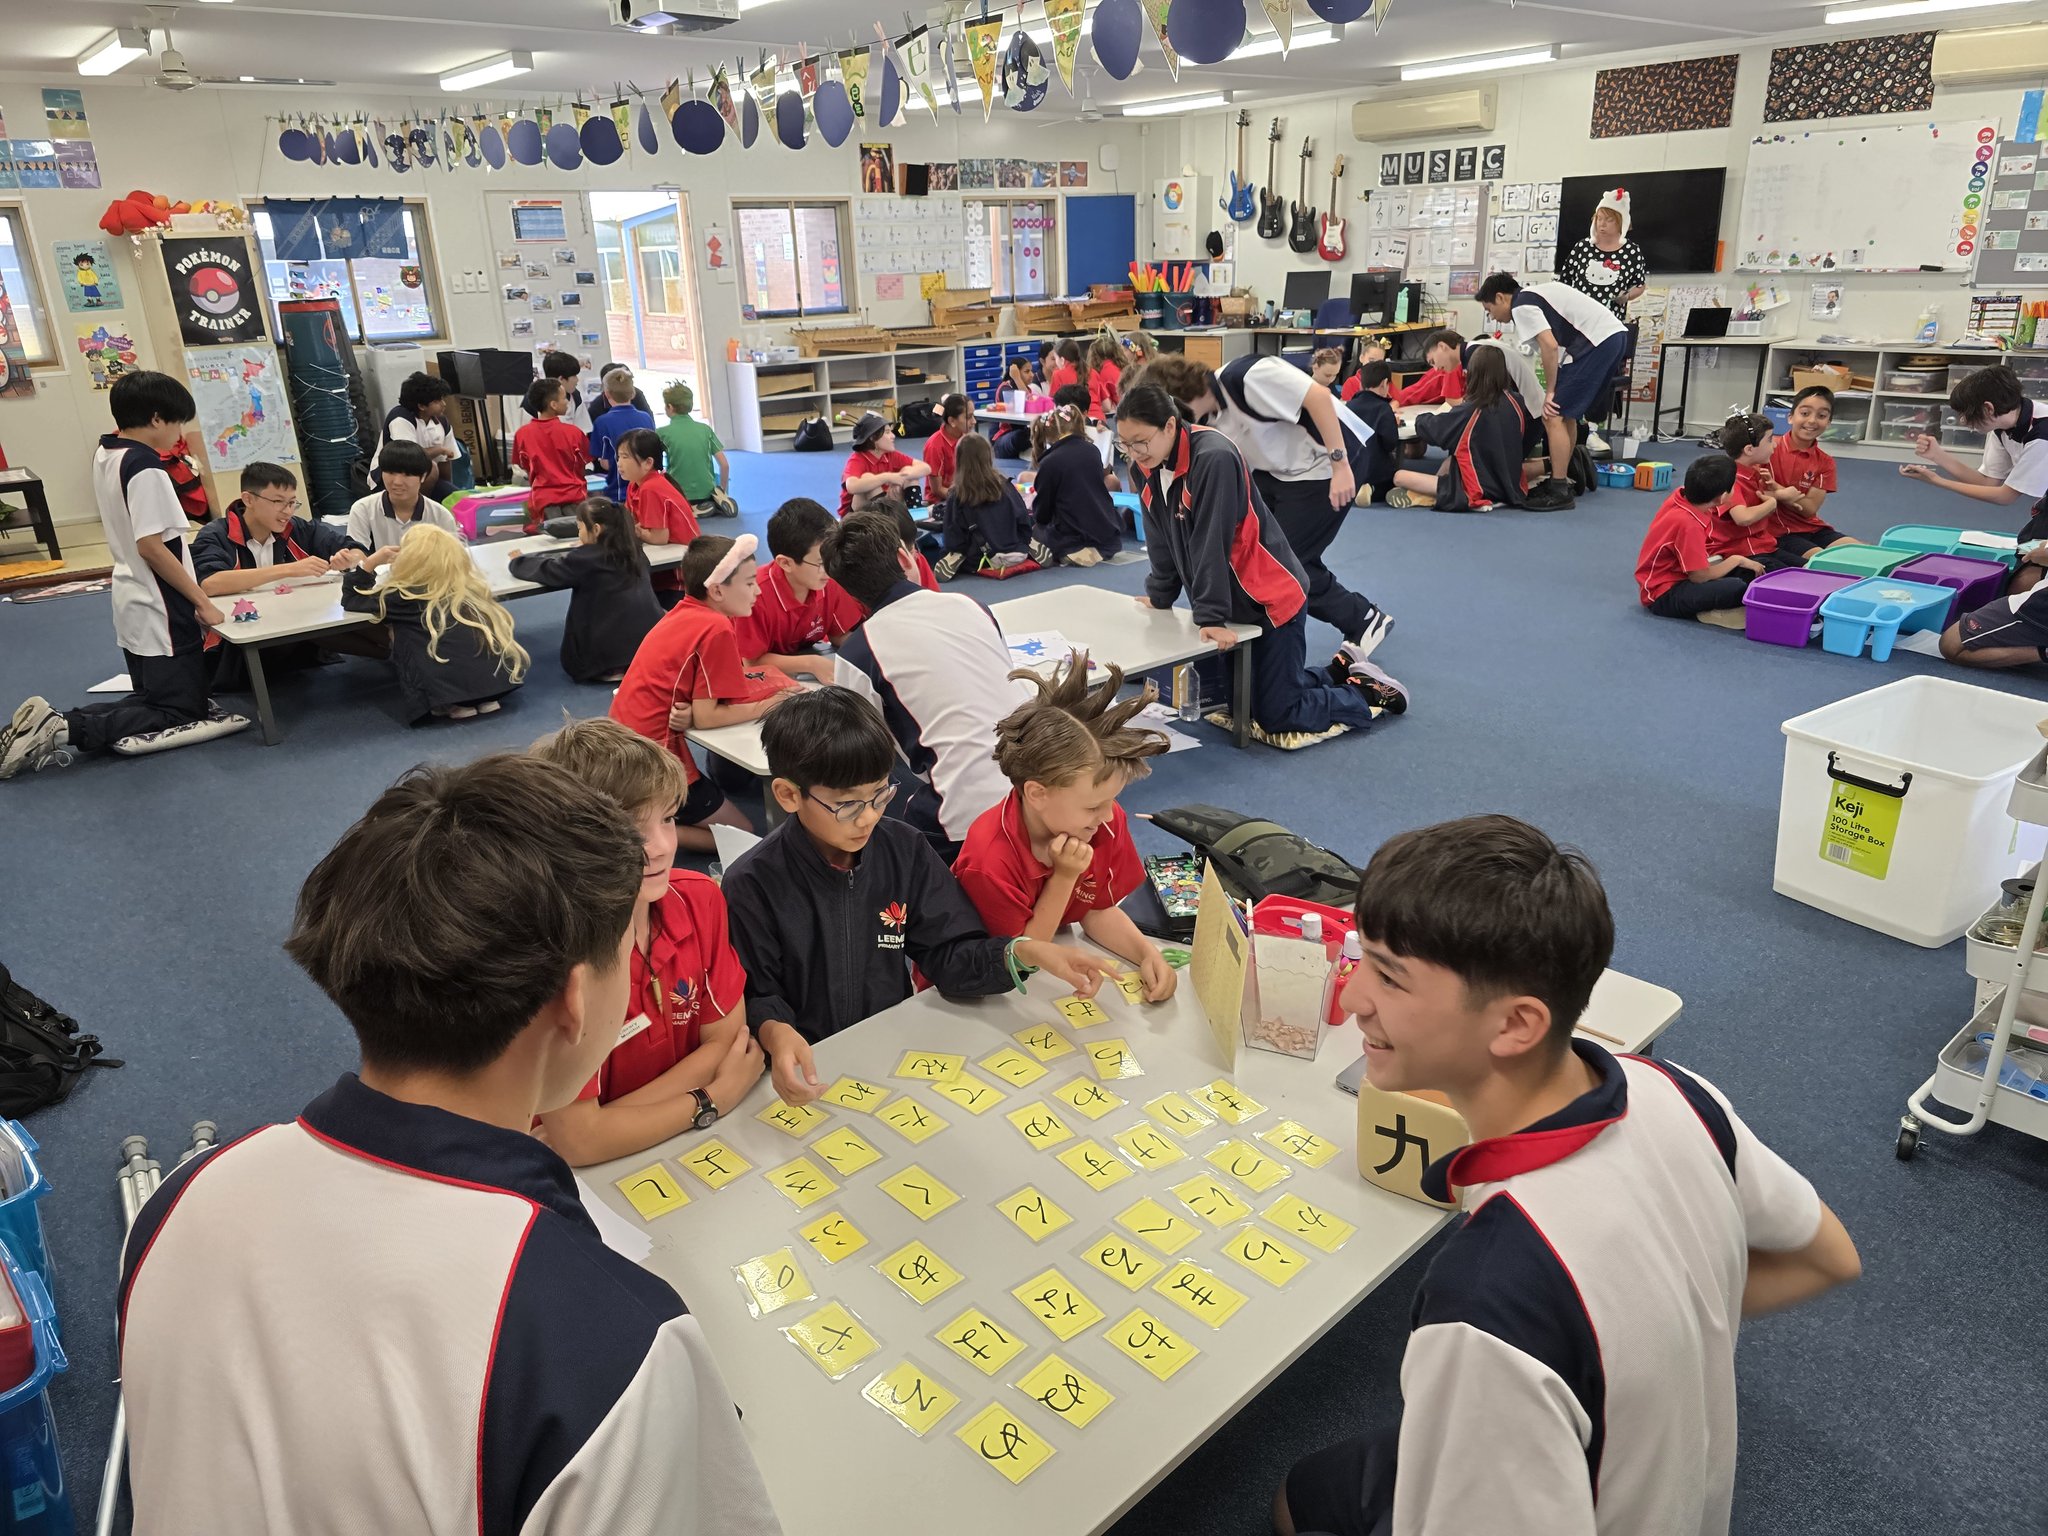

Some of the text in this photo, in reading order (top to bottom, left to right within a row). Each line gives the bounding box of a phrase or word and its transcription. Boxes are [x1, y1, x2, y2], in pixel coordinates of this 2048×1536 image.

[1382, 148, 1502, 176] MUSIC
[1508, 192, 1514, 205] F
[1541, 191, 1550, 203] G
[1497, 224, 1506, 237] C
[175, 247, 241, 275] POKÉMON
[189, 308, 252, 330] TRAINER
[1835, 796, 1864, 819] Keji
[1830, 823, 1865, 841] Storage
[1867, 835, 1886, 848] Box
[1832, 815, 1871, 834] 100 Litre
[877, 932, 905, 943] LEEM
[1065, 1001, 1096, 1018] む
[1026, 1031, 1057, 1050] み
[911, 1058, 949, 1075] を
[996, 1059, 1027, 1077] こ
[1094, 1048, 1124, 1066] ち
[840, 1082, 875, 1102] れ
[951, 1087, 987, 1104] て
[1073, 1086, 1109, 1106] わ
[1206, 1090, 1245, 1112] も
[890, 1106, 929, 1127] た
[1023, 1114, 1061, 1138] ゆ
[827, 1142, 866, 1161] い
[1132, 1132, 1172, 1160] け
[693, 1149, 731, 1177] よ
[1083, 1152, 1116, 1178] す
[1231, 1160, 1264, 1177] つ
[632, 1179, 670, 1198] し
[785, 1170, 818, 1193] さ
[903, 1183, 932, 1205] く
[1188, 1187, 1235, 1215] に
[1015, 1196, 1048, 1224] ん
[1297, 1206, 1328, 1233] か
[809, 1220, 847, 1246] ふ
[1100, 1247, 1144, 1275] る
[1243, 1241, 1292, 1265] ら
[898, 1255, 940, 1285] あ
[1168, 1273, 1217, 1306] ま
[1035, 1288, 1078, 1319] な
[953, 1320, 1009, 1359] は
[1127, 1320, 1176, 1359] お
[891, 1379, 937, 1411] ろ
[1038, 1374, 1086, 1411] ぬ
[980, 1422, 1027, 1460] め
